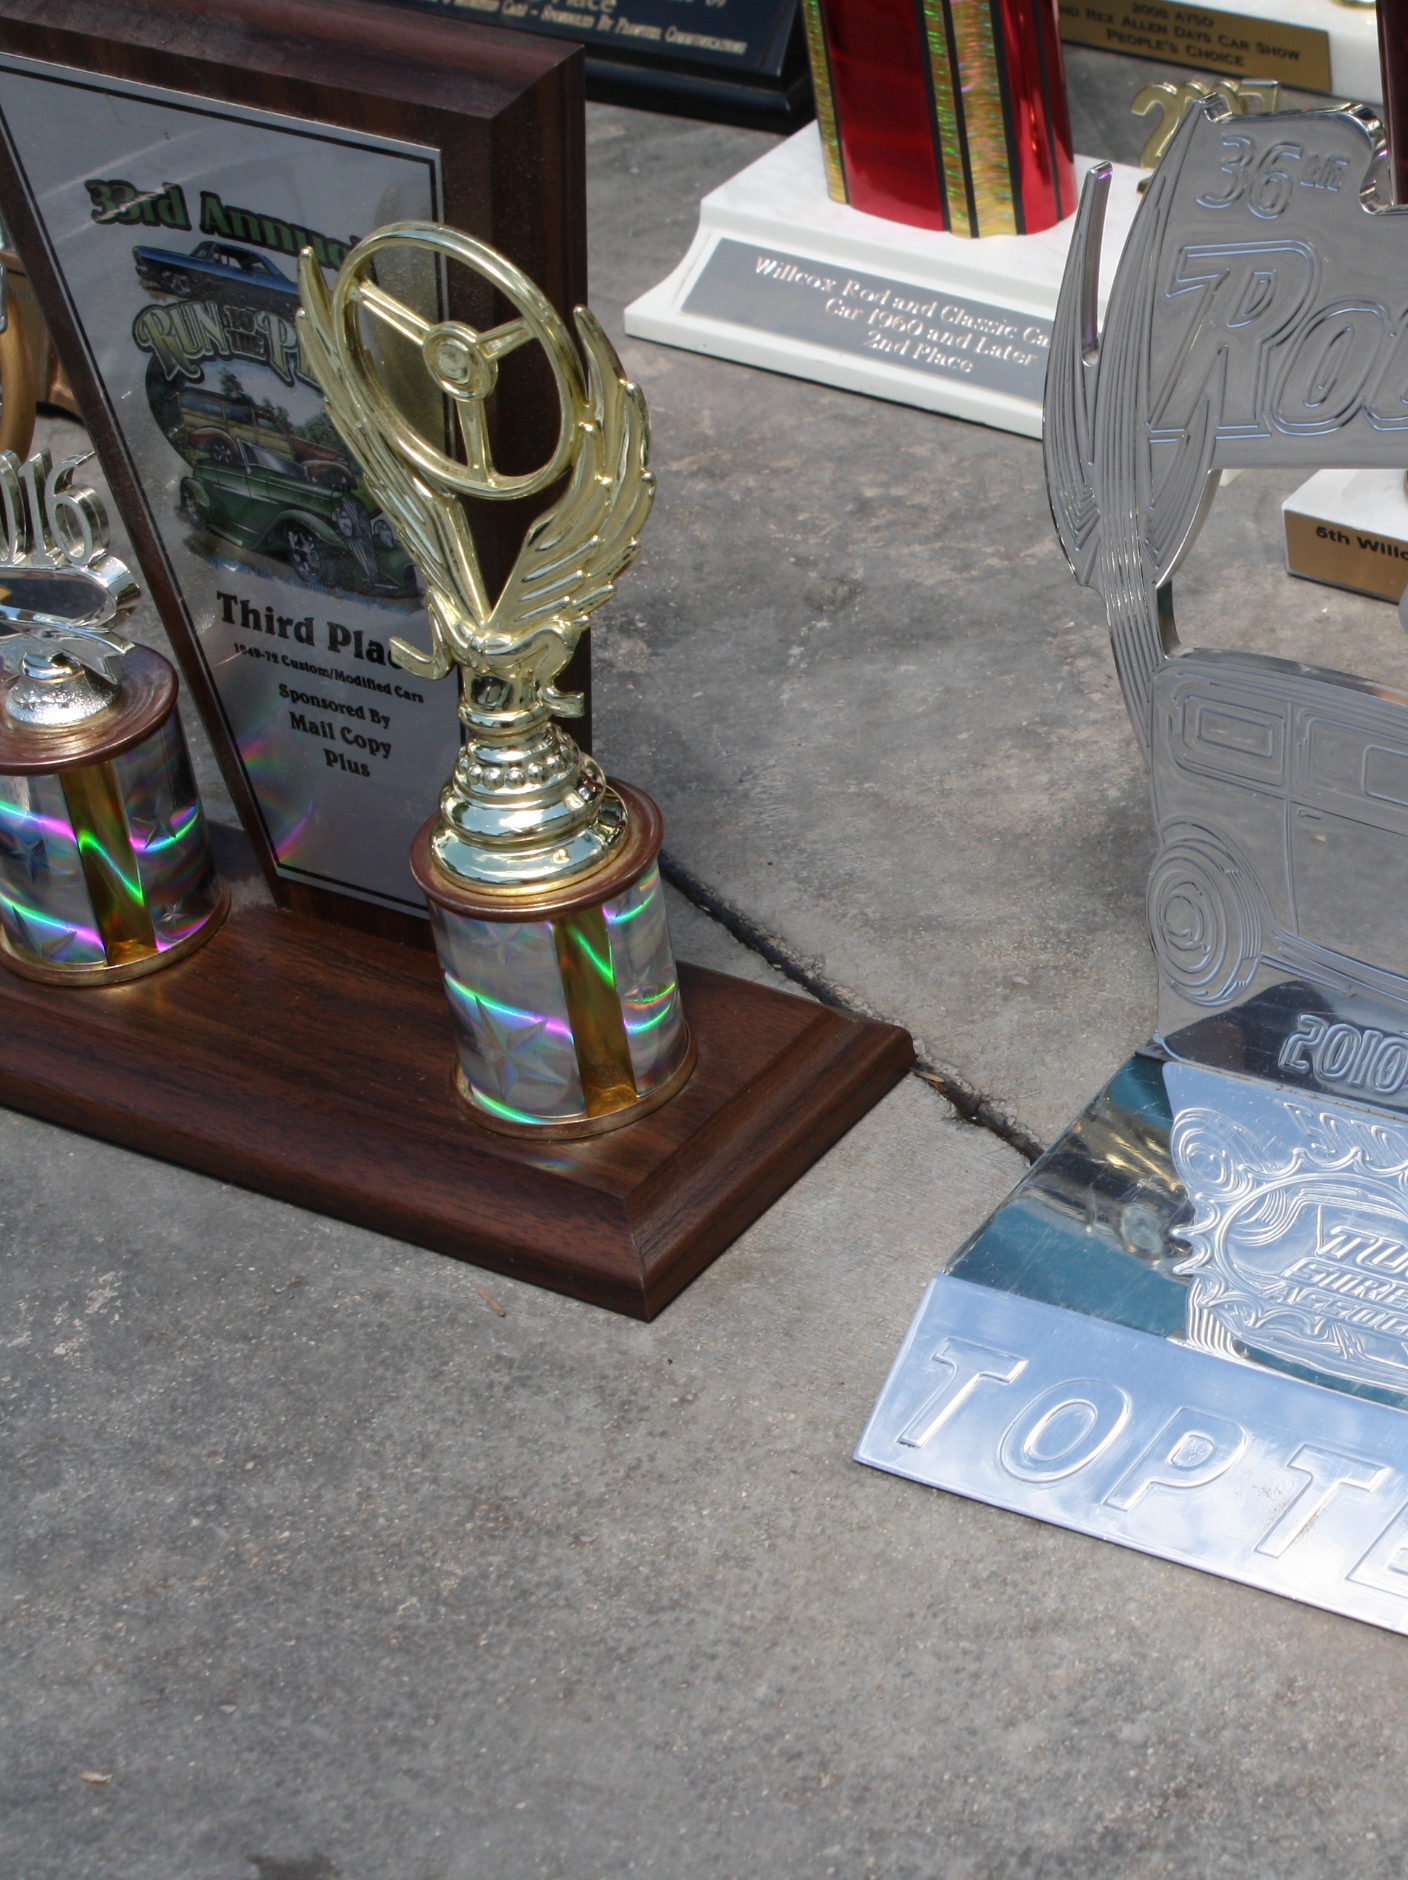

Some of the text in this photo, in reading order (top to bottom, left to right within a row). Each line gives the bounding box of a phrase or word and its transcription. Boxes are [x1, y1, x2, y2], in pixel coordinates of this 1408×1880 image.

[1086, 8, 1115, 25] REX
[1121, 16, 1168, 36] ALLEN
[1175, 26, 1211, 44] DAYS
[1218, 34, 1251, 51] CAR
[1256, 41, 1300, 61] SHOW
[1106, 28, 1246, 67] PEOPLE'S CHOICE
[84, 178, 364, 273] 33rd Annua
[754, 255, 1050, 348] Willcox Rod and Classic Ca
[132, 299, 232, 384] RUN
[824, 297, 1038, 367] Car 1960 and Later
[861, 329, 974, 374] 2nd Place
[216, 590, 315, 647] Third
[278, 682, 391, 730] Sponsored By
[281, 655, 392, 696] Custom/Modified
[393, 685, 425, 704] Cars
[288, 711, 393, 760] Mail Copy
[322, 748, 371, 778] Plus
[895, 1336, 1248, 1515] TOP
